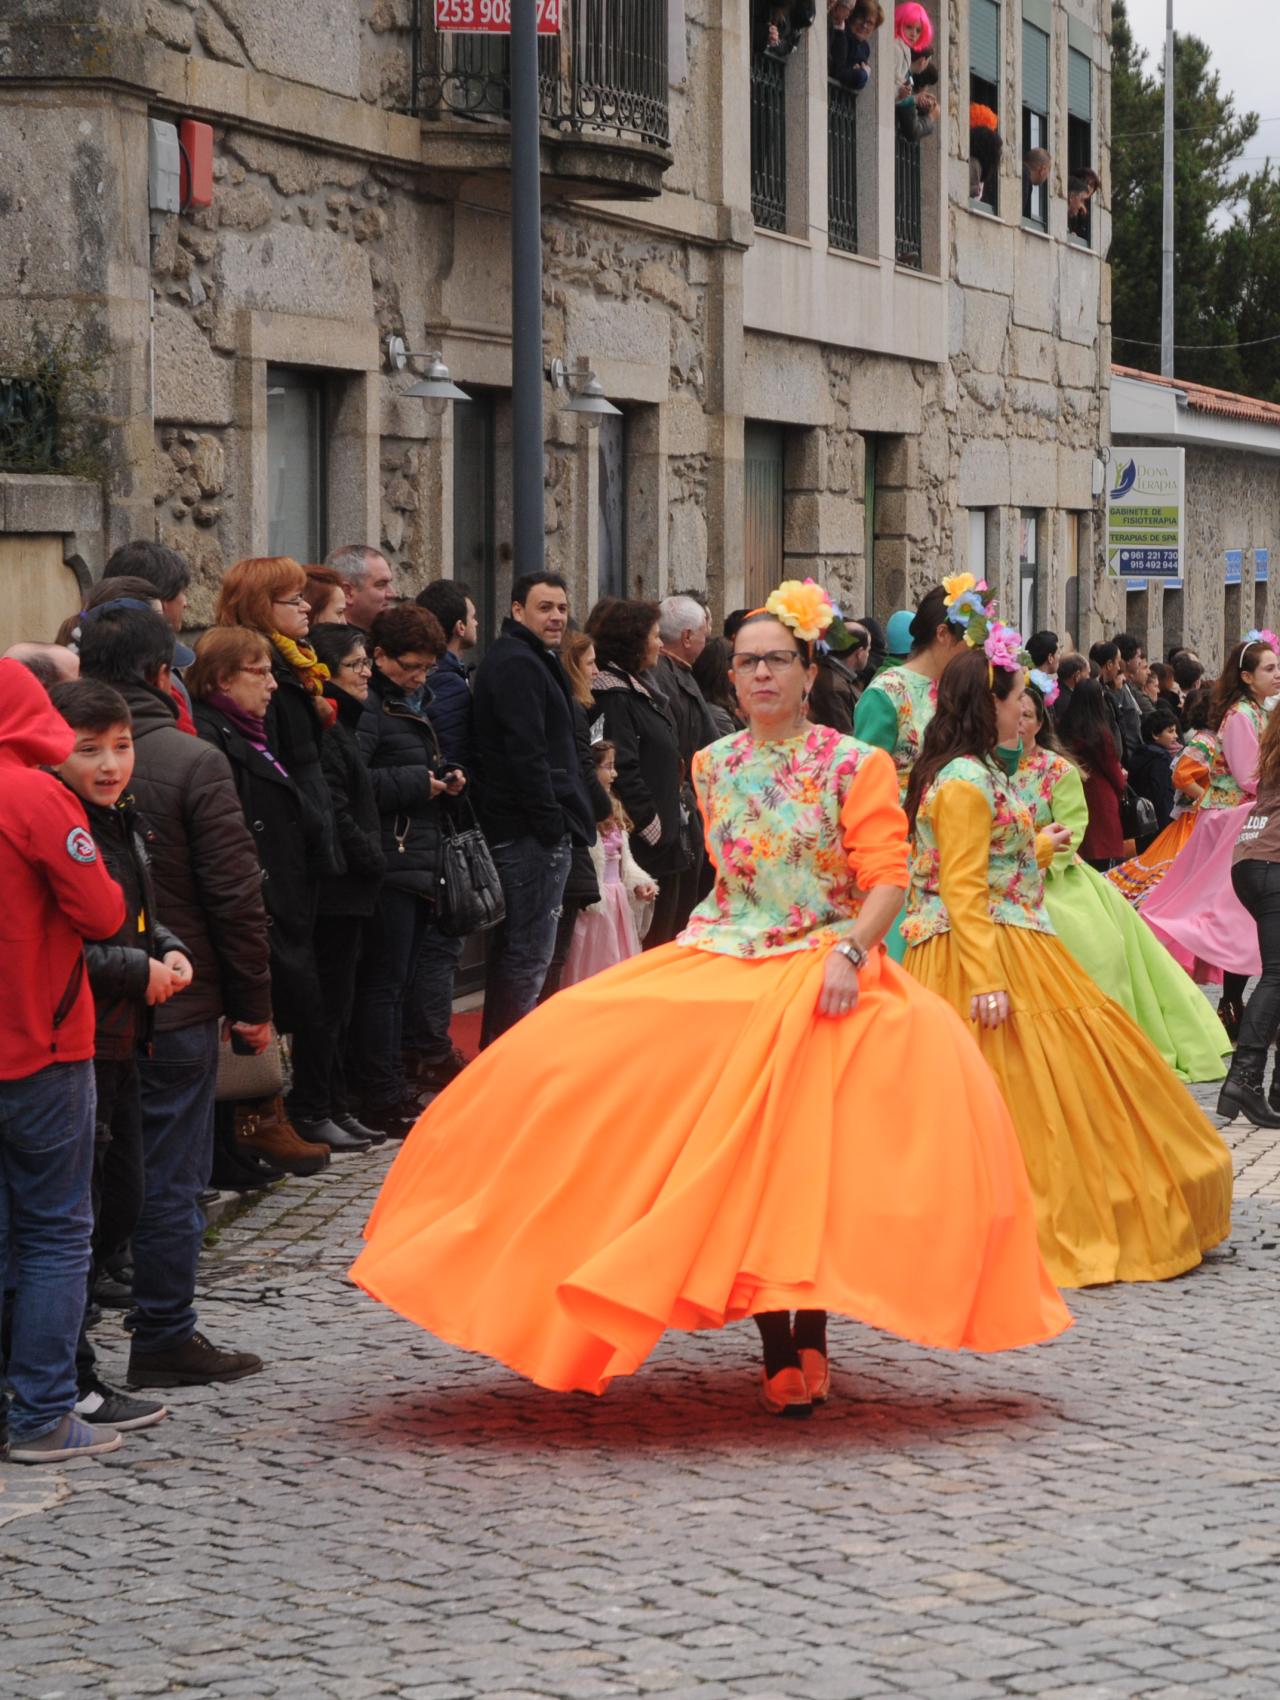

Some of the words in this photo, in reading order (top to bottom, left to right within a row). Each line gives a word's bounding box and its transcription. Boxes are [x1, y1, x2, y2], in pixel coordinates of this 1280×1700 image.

[438, 0, 474, 22] 253
[1109, 508, 1149, 516] GABINETE
[1151, 508, 1162, 516] DE
[1122, 517, 1178, 525] FISIOTERAPIA
[1109, 534, 1148, 542] TERAPIAS
[1150, 534, 1160, 542] DE
[1161, 534, 1178, 542] SPA
[1130, 551, 1144, 560] 961
[1147, 551, 1161, 560] 221
[1163, 551, 1178, 560] 730
[1130, 560, 1144, 569] 915
[1145, 560, 1161, 569] 492
[1162, 560, 1178, 569] 944
